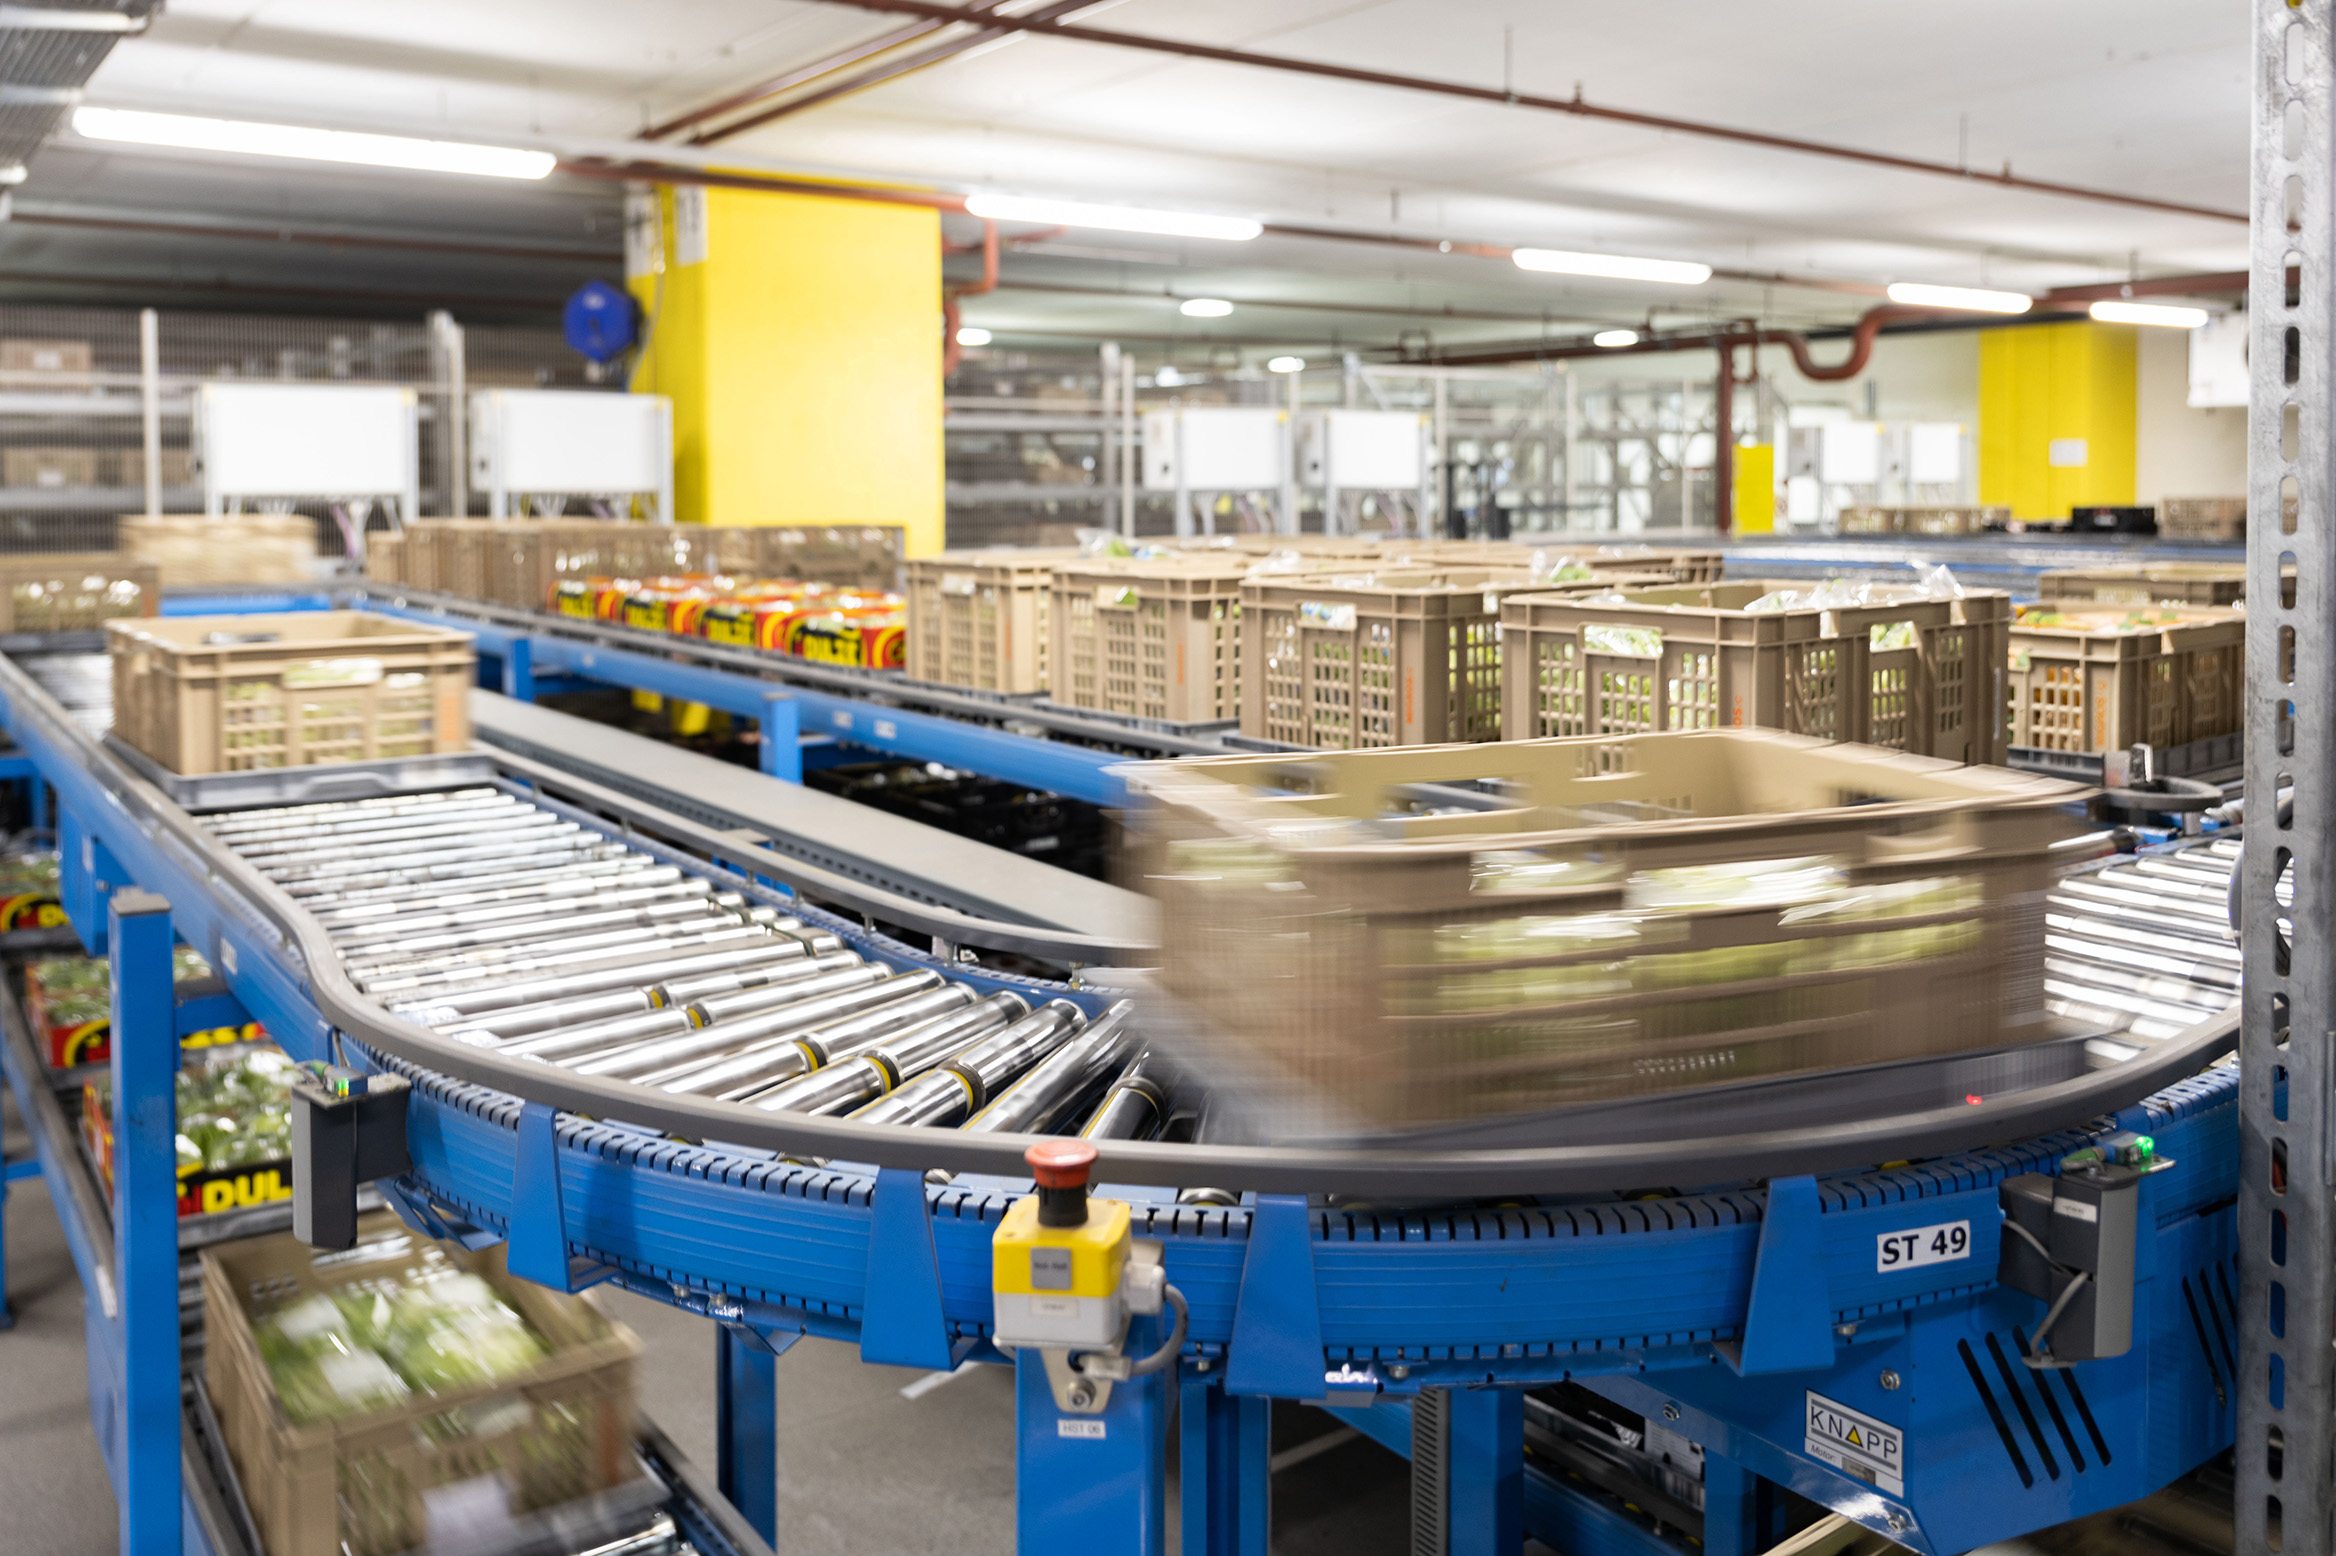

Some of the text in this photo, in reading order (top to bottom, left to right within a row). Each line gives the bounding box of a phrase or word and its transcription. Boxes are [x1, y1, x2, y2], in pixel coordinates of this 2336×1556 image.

[202, 1170, 293, 1213] DUL
[1882, 1226, 1967, 1265] ST 49
[1811, 1405, 1897, 1459] KNAPP
